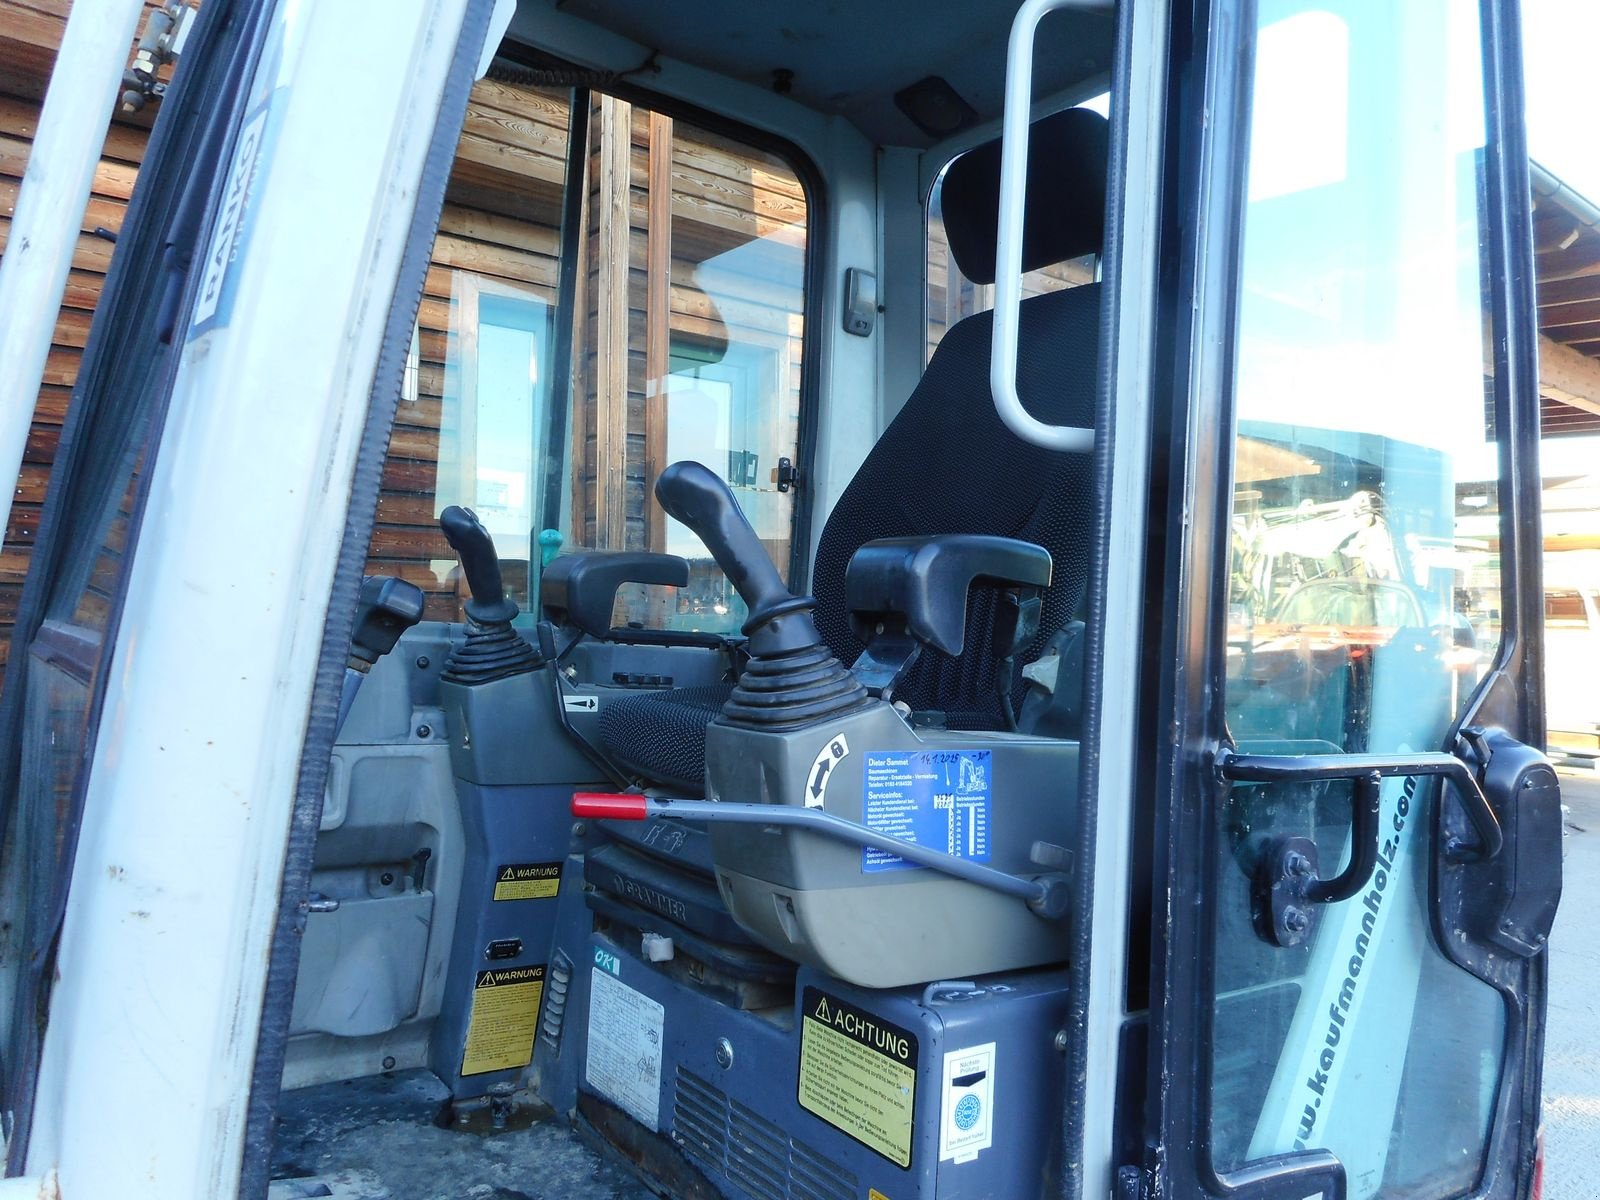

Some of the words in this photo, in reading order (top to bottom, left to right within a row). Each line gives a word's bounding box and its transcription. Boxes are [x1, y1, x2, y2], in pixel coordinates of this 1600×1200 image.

[517, 867, 558, 878] WARNUNG
[495, 968, 542, 981] WARNUNG
[1293, 776, 1416, 1150] w.kaufmannholz.com
[834, 1009, 909, 1060] ACHTUNG
